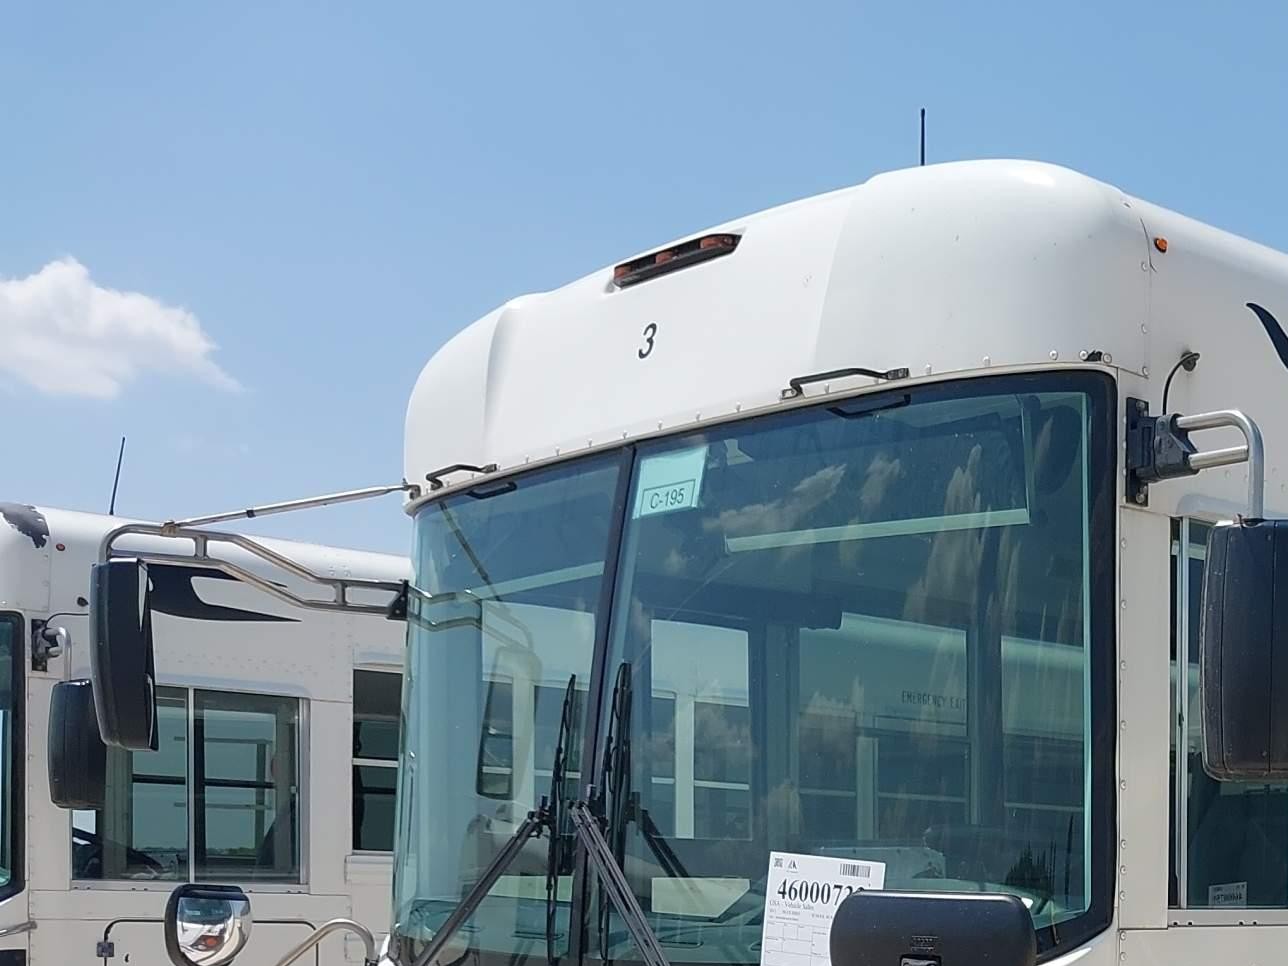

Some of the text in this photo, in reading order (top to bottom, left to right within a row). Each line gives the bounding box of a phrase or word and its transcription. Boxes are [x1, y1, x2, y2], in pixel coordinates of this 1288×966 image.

[637, 322, 657, 360] 3
[650, 488, 685, 509] C-195
[777, 878, 865, 906] 460007
